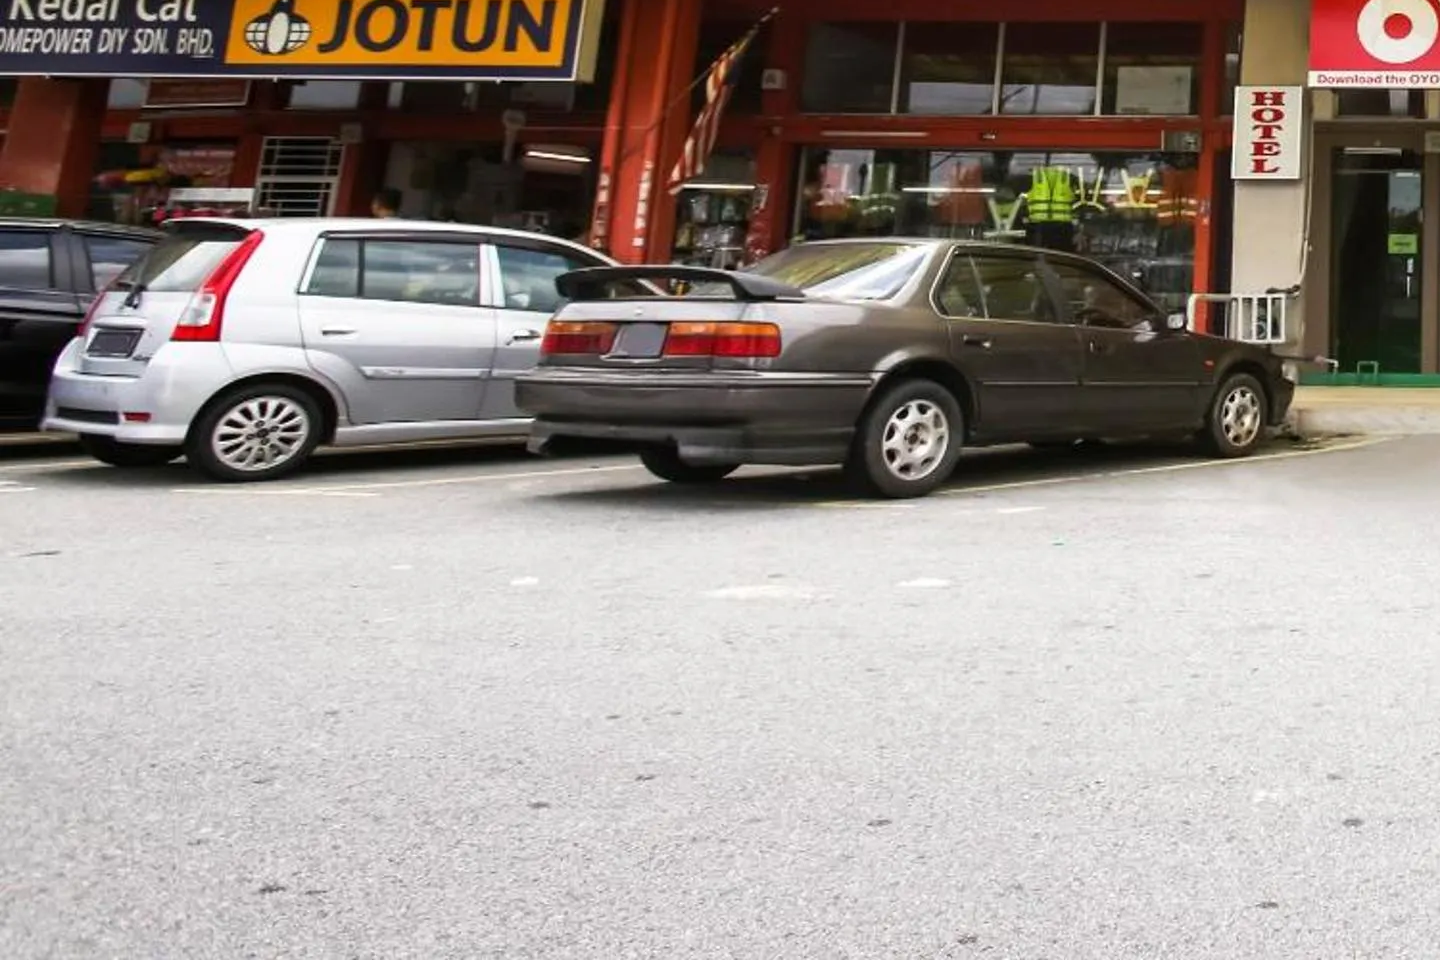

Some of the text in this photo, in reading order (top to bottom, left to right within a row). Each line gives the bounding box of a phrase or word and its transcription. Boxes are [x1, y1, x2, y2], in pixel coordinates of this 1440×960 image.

[97, 28, 129, 54] DIY
[131, 28, 168, 54] SDN.
[176, 28, 214, 55] BHD.
[1317, 74, 1381, 85] Download
[1385, 74, 1406, 85] the
[1410, 74, 1439, 85] OYO
[1250, 91, 1287, 173] HOTEL
